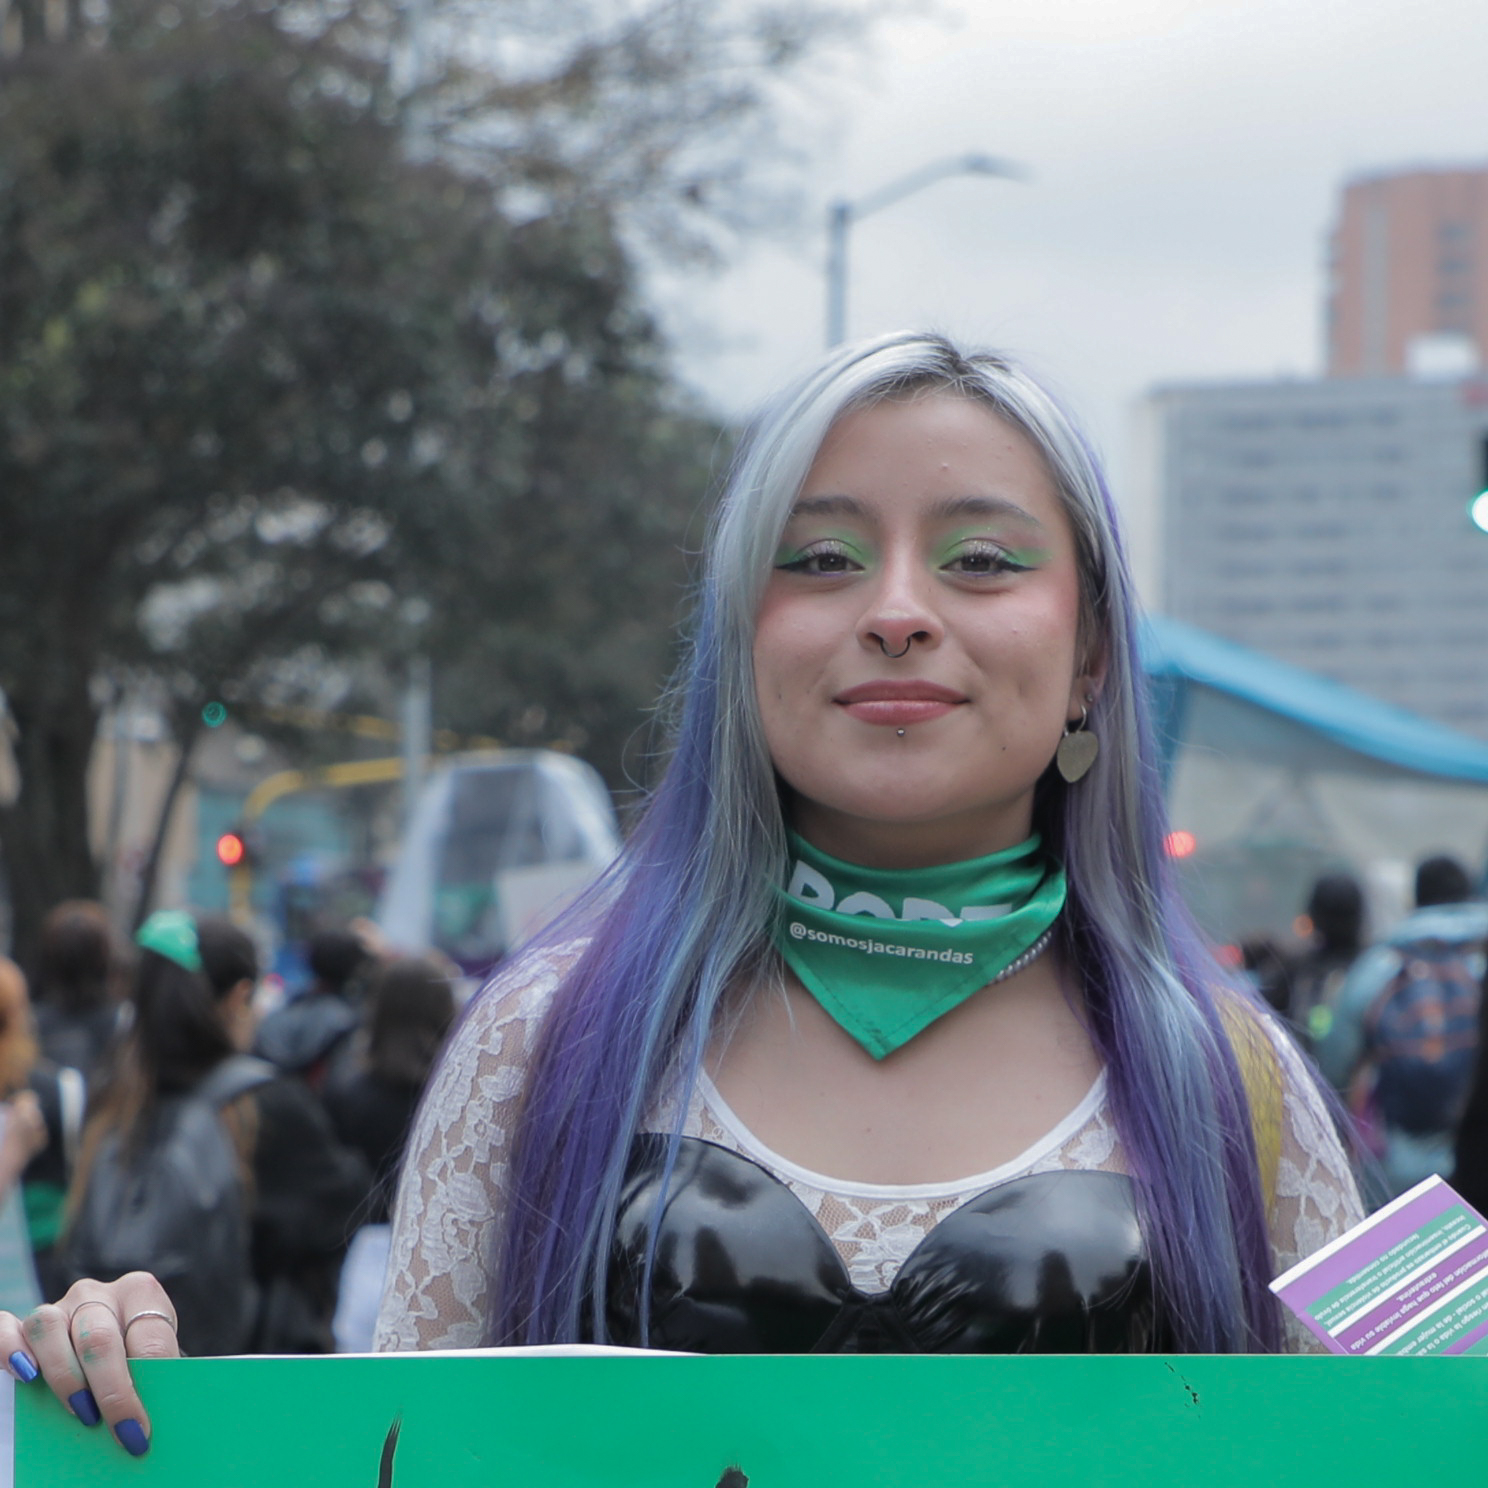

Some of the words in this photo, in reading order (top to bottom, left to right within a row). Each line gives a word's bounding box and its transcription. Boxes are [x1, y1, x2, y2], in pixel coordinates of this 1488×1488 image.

[789, 922, 974, 965] @somosjacarandas
[1447, 1222, 1471, 1242] Cuando
[1413, 1242, 1442, 1265] embarazo
[1379, 1266, 1406, 1288] producto
[1442, 1273, 1455, 1285] del
[1415, 1289, 1430, 1302] que
[1429, 1280, 1444, 1294] feto
[1345, 1291, 1372, 1312] violencia
[1398, 1298, 1418, 1315] haga
[1455, 1298, 1476, 1315] social
[1373, 1311, 1402, 1334] inviable
[1442, 1314, 1453, 1324] de
[1459, 1306, 1482, 1325] riesgo
[1364, 1329, 1375, 1339] su
[1415, 1324, 1437, 1343] mujer
[1439, 1327, 1455, 1342] vida
[1349, 1336, 1367, 1351] vida
